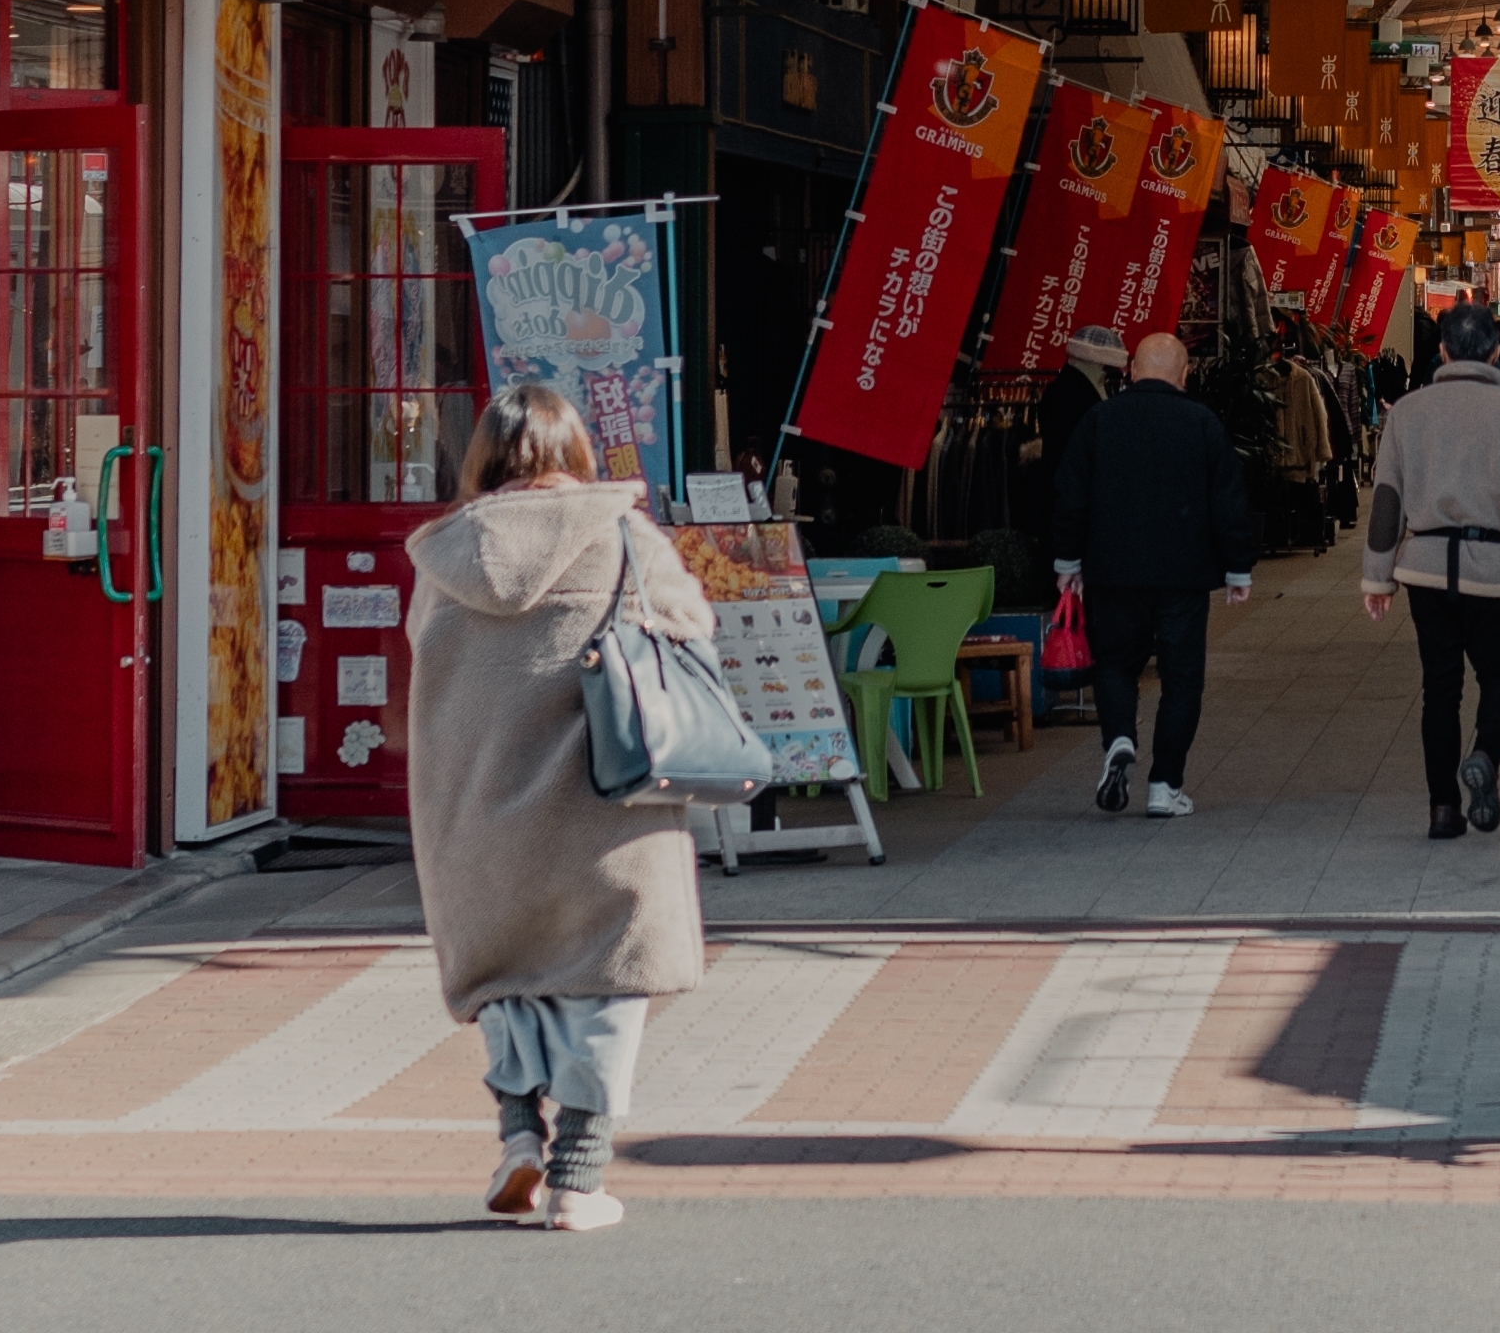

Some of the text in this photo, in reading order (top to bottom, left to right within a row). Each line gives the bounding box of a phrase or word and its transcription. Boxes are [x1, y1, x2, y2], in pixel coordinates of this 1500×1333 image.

[915, 125, 984, 160] GRAMPUS
[1059, 178, 1108, 204] GRAMPUS
[1140, 179, 1187, 200] GRAMPUS
[895, 185, 959, 339] この街の想いが
[1049, 225, 1090, 347] この街の想いが
[1132, 218, 1171, 324] この街の想いが
[857, 246, 910, 391] チカラになる
